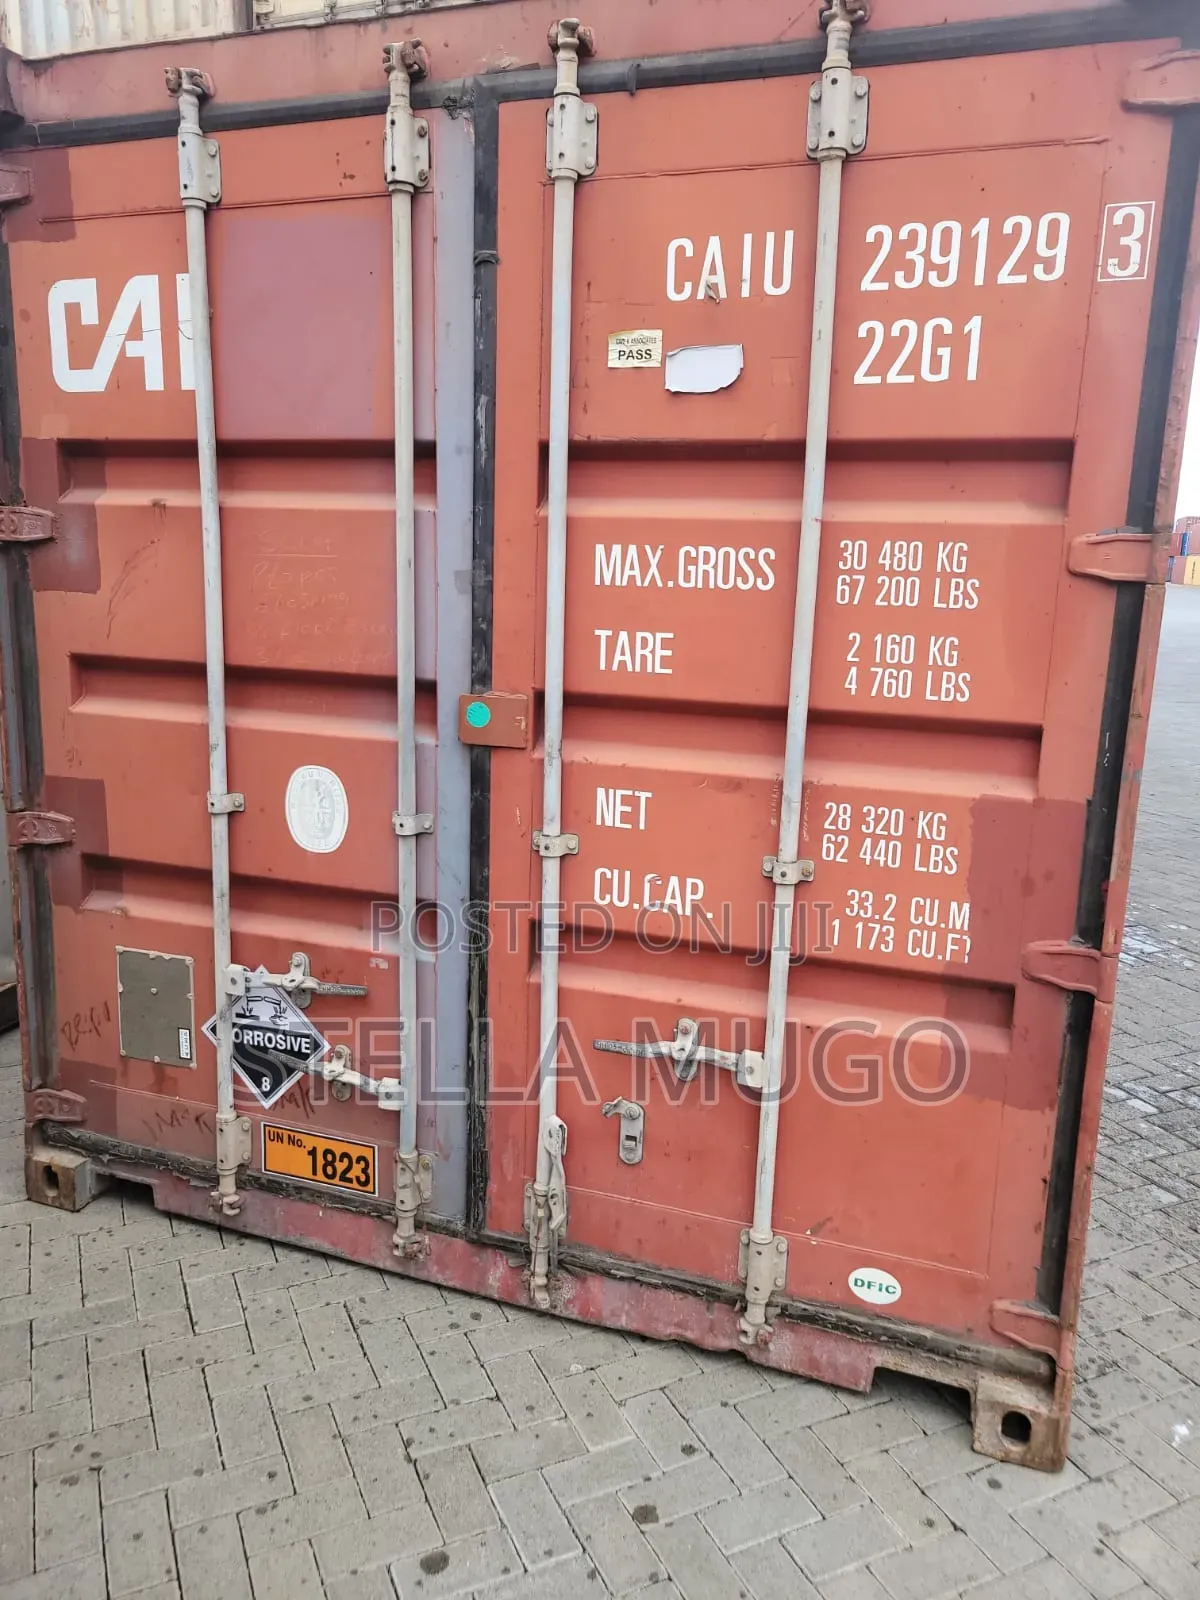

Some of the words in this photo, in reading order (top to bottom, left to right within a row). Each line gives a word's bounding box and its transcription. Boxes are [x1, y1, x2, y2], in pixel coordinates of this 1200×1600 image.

[666, 229, 795, 303] CAIU
[860, 211, 1071, 292] 239129
[1108, 205, 1147, 278] 3
[618, 348, 652, 361] PASS
[853, 314, 983, 385] 22G1
[594, 543, 776, 592] MAX.GROSS
[838, 539, 868, 571] 30
[878, 540, 923, 573] 480
[936, 541, 969, 574] KG
[836, 574, 866, 606] 67
[875, 576, 920, 607] 200
[933, 578, 980, 610] LBS
[594, 629, 675, 675] TARE
[846, 632, 861, 662] 2
[873, 633, 916, 665] 160
[927, 635, 960, 668] KG
[844, 666, 858, 696] 4
[870, 668, 913, 700] 760
[924, 671, 971, 703] LBS
[595, 787, 653, 831] NET
[823, 801, 852, 832] 28
[861, 805, 905, 837] 320
[916, 810, 949, 842] KG
[821, 833, 850, 864] 62
[858, 838, 903, 870] 440
[914, 843, 960, 876] LBS
[594, 867, 716, 920] CU.CAP.
[844, 888, 898, 922] 33.2
[909, 896, 971, 932] CU.M
[831, 918, 841, 948] 1
[854, 921, 897, 952] 173
[232, 1028, 312, 1054] ORROSIVE
[261, 1076, 271, 1092] 8
[268, 1129, 285, 1145] UN
[287, 1134, 306, 1149] No.
[307, 1146, 371, 1188] 1823
[853, 1277, 898, 1295] DFIC
